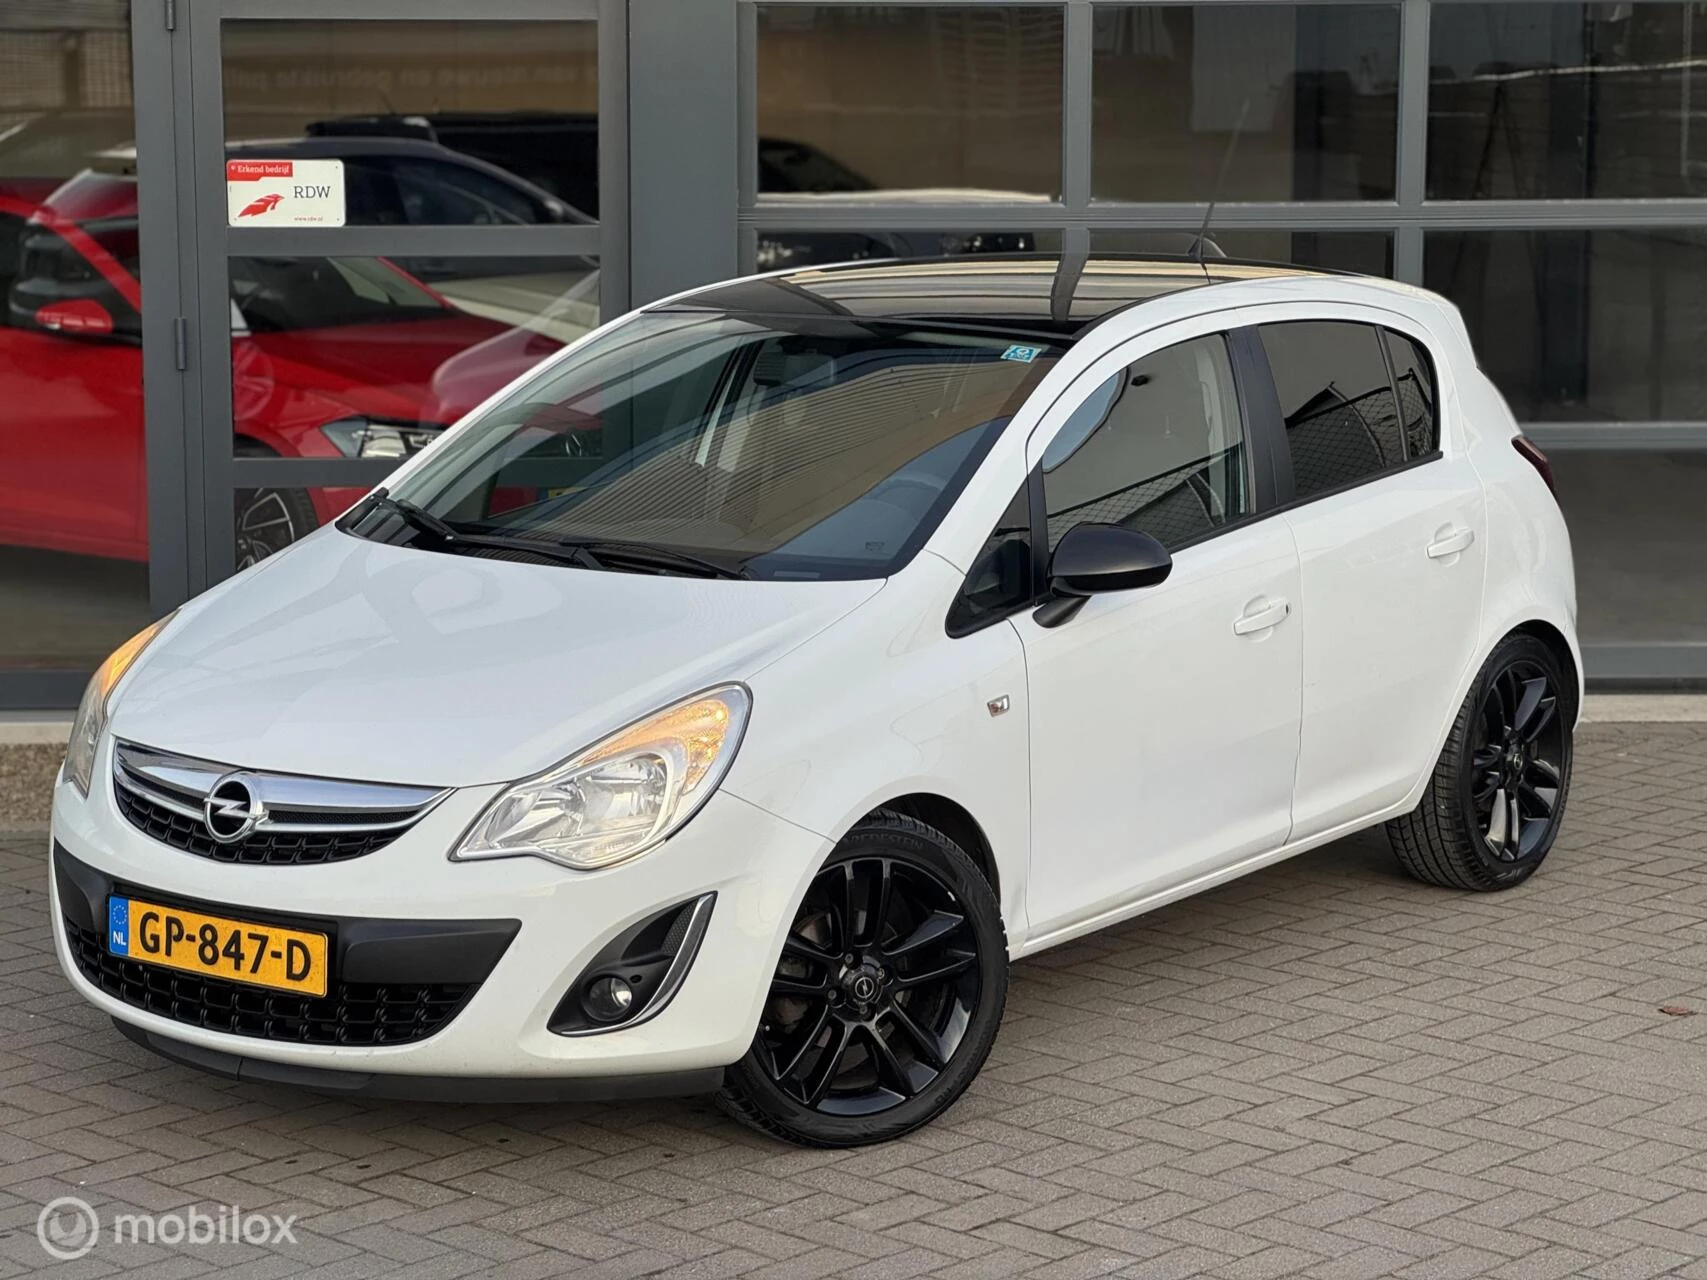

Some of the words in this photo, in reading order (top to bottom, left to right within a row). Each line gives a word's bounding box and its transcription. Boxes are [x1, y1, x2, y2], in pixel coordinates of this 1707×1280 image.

[237, 164, 264, 173] Erkend
[265, 164, 290, 175] bedrijf
[294, 186, 331, 199] RDW
[112, 930, 127, 946] NL
[139, 911, 312, 982] GP-847-D
